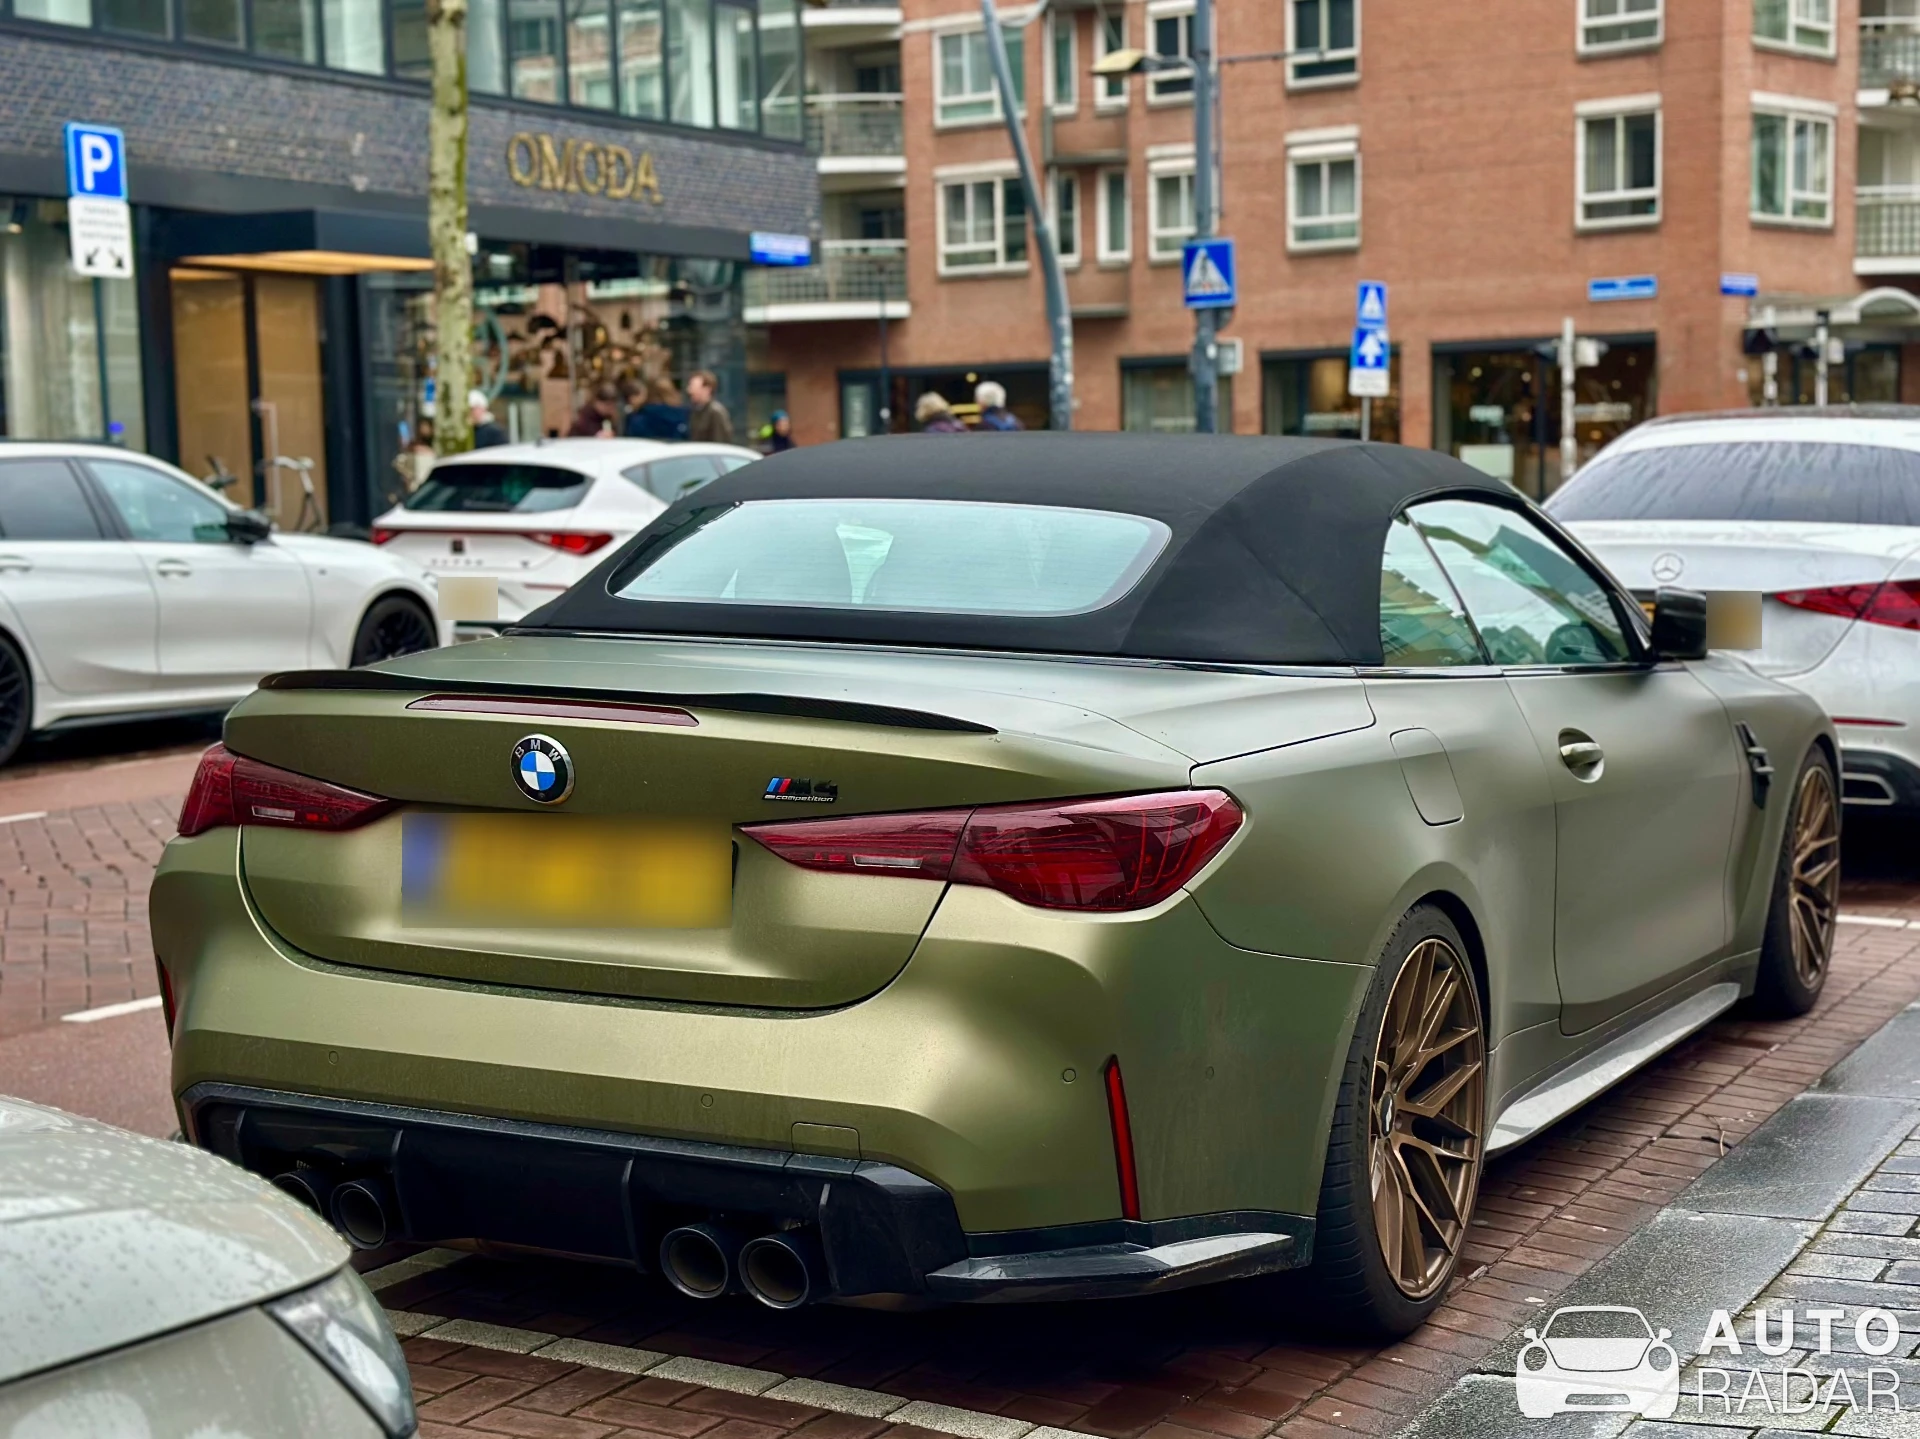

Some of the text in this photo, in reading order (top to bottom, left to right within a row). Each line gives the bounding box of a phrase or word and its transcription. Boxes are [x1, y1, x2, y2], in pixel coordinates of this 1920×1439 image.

[80, 133, 113, 191] P
[507, 132, 663, 204] OMODA
[514, 739, 562, 762] BMW
[775, 794, 834, 803] competition
